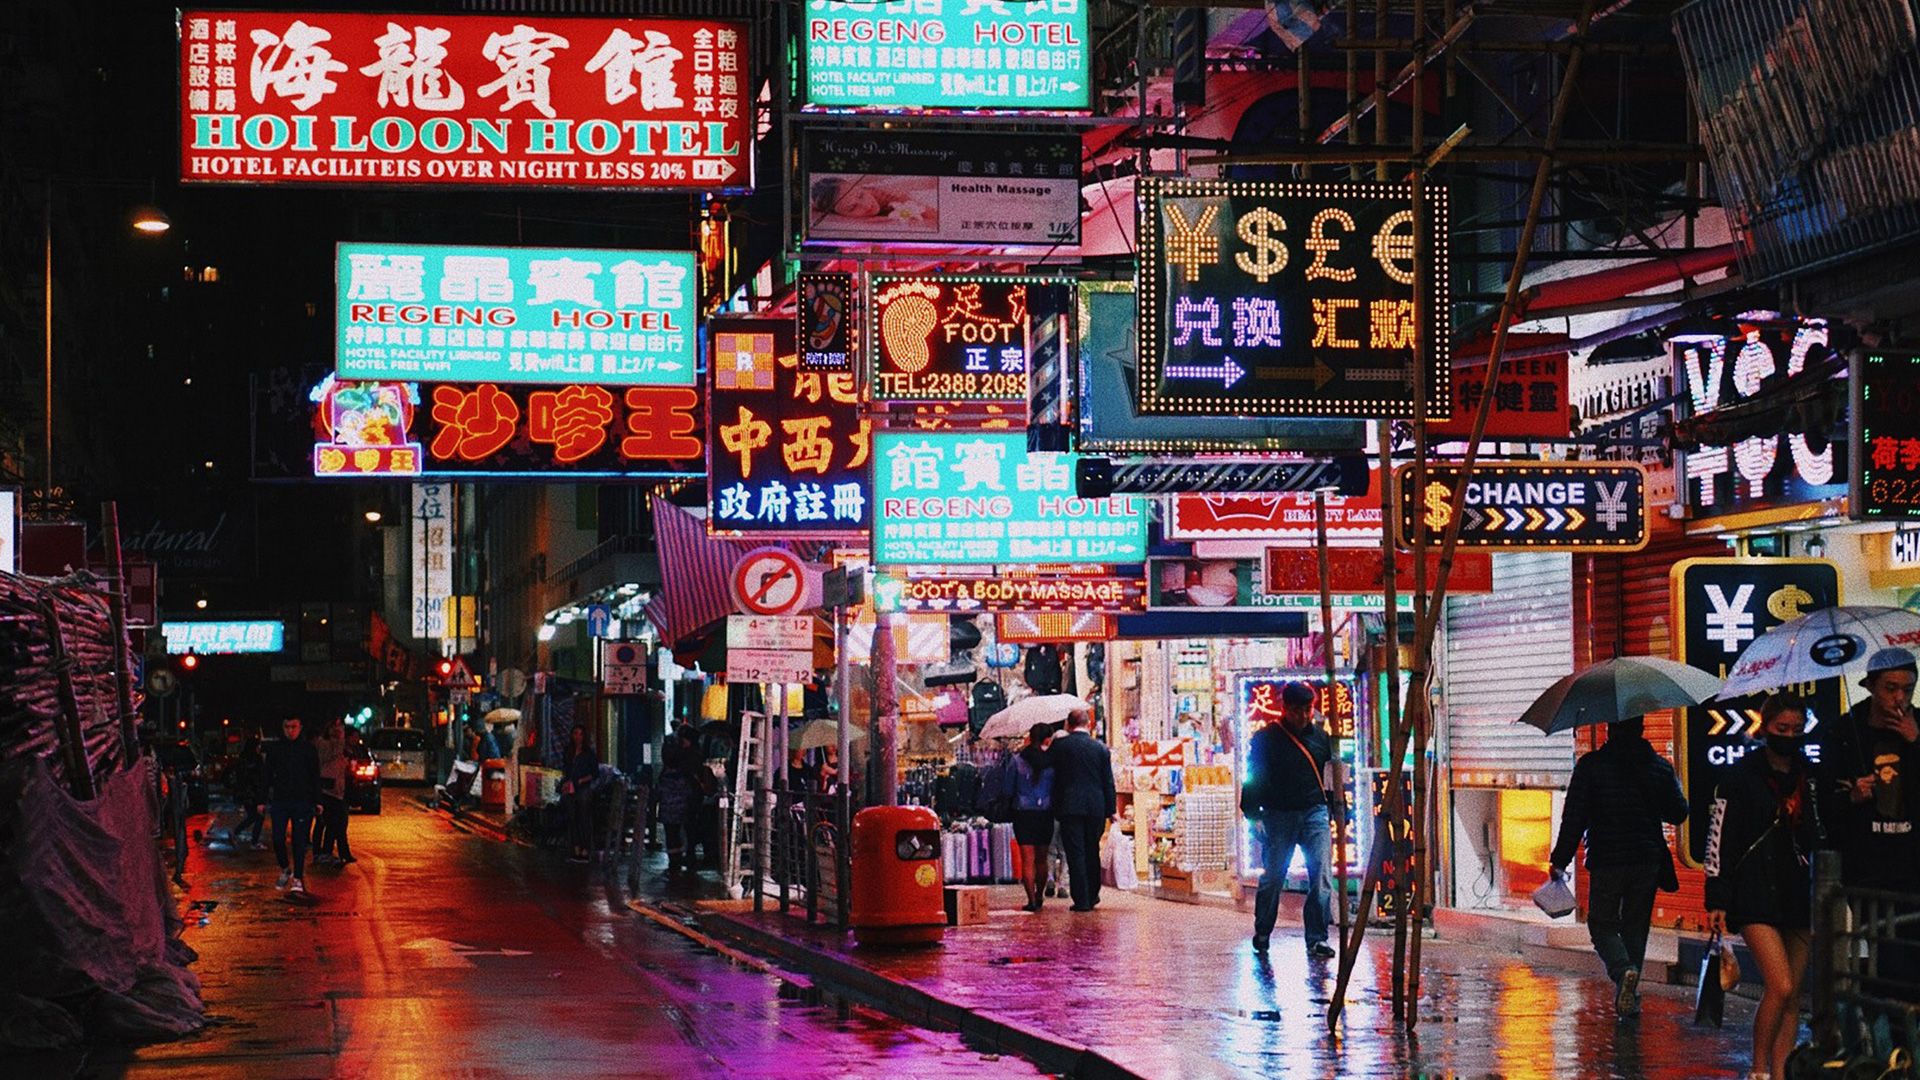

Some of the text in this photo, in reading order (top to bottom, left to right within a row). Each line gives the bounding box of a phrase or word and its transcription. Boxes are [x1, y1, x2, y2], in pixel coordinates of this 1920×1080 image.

[810, 19, 1080, 46] REGENG HOTEL
[249, 20, 684, 118] 海龍賓館
[811, 72, 844, 83] HOTEL
[811, 85, 845, 96] HOTEL
[191, 114, 740, 156] HOI LOON HOTEL
[890, 142, 954, 161] Massage
[191, 157, 686, 180] HOTEL FACILITEIS OVER NIGHT LESS 20%
[952, 184, 1051, 196] Health Massage
[1166, 203, 1220, 282] ¥
[1235, 206, 1289, 283] $
[1305, 207, 1357, 283] £
[346, 254, 687, 308] 麗晶賓館
[350, 304, 681, 333] REGENG HOTEL
[943, 323, 1015, 343] FOOT
[346, 348, 387, 359] HOTEL
[391, 349, 446, 361] FACILITY
[965, 347, 1024, 371] 正宗
[346, 360, 387, 370] HOTEL
[391, 361, 419, 371] FREE
[1490, 361, 1558, 375] REEN
[719, 480, 865, 523] 政府註冊
[884, 496, 1139, 518] REGENG HOTEL
[1424, 481, 1628, 532] $ CHANGE ¥
[1347, 508, 1383, 522] LAN
[902, 581, 951, 599] FOOT
[973, 581, 1028, 600] BODY
[1031, 582, 1125, 600] MASSAGE
[1251, 595, 1302, 606] HOTEL
[1313, 596, 1352, 606] FEE
[1704, 584, 1755, 653] ¥
[795, 670, 809, 681] 12
